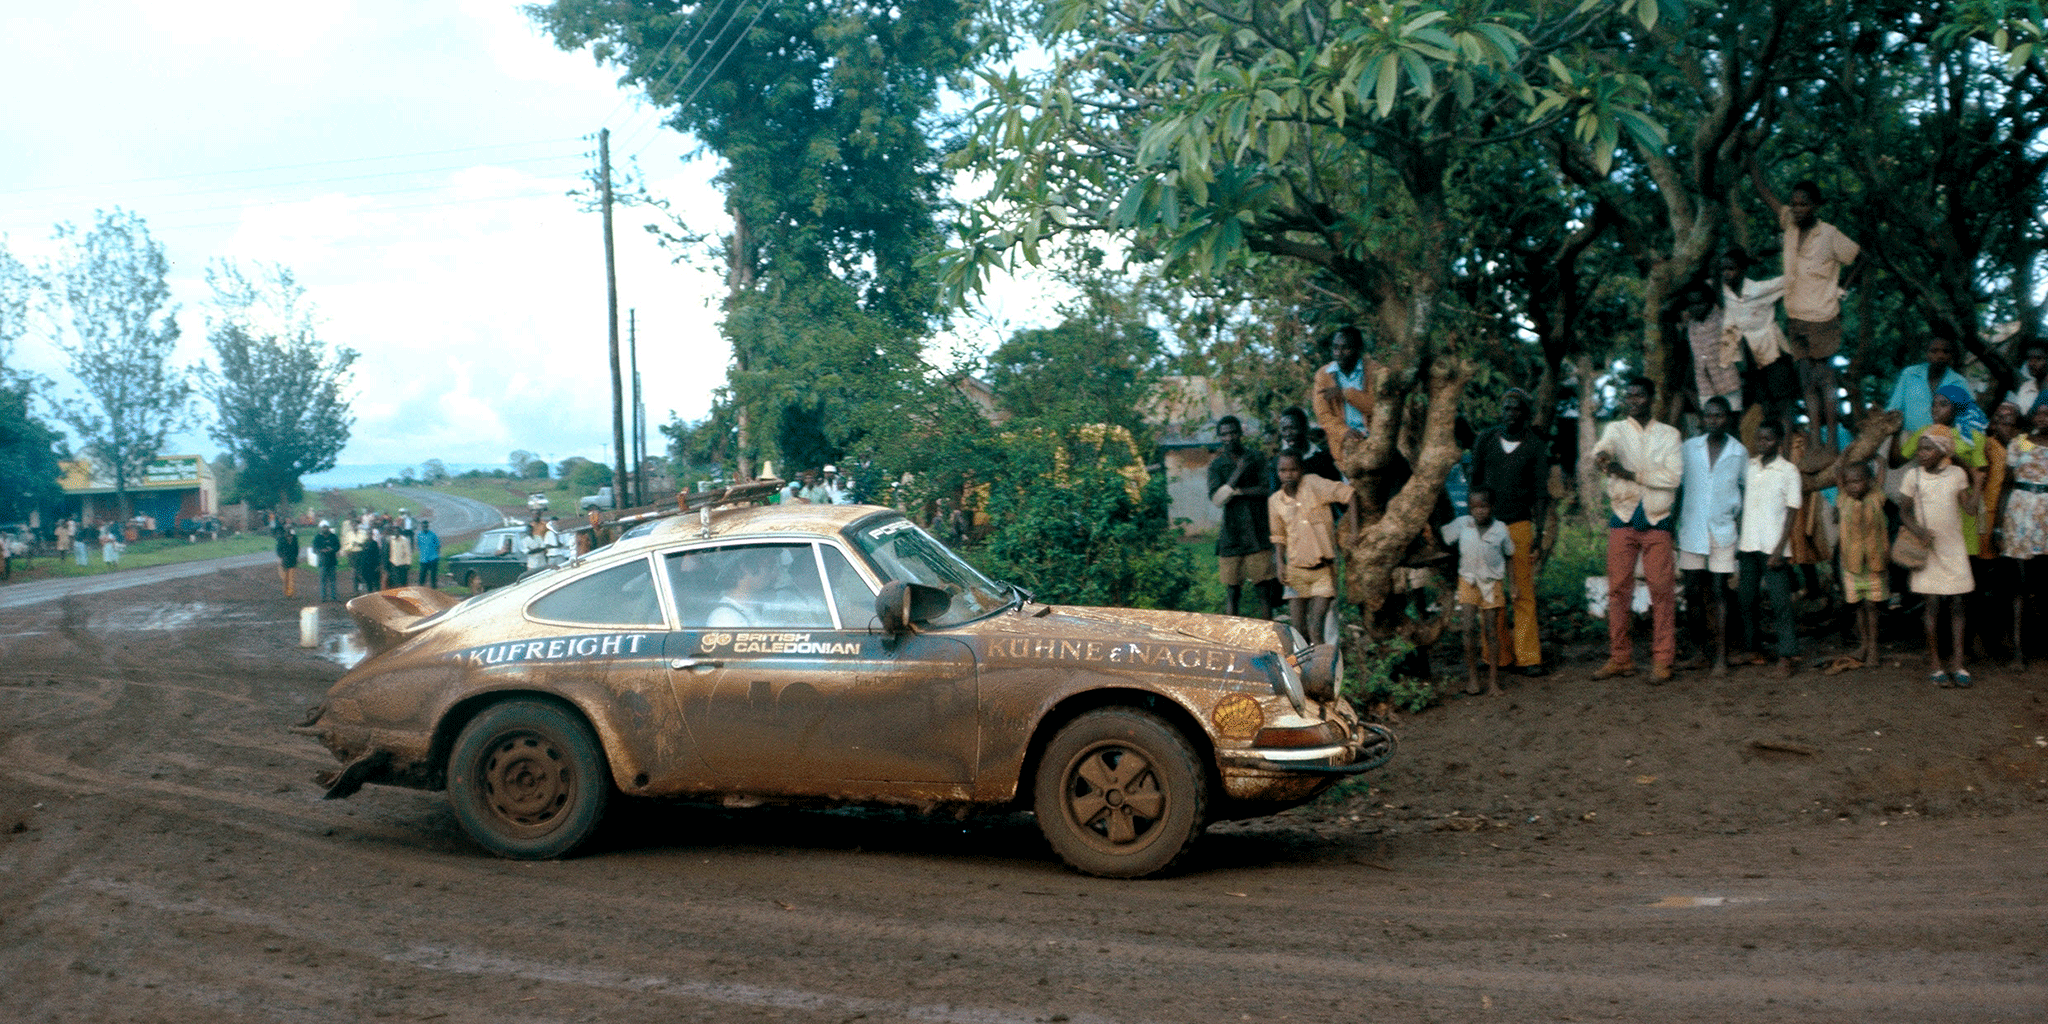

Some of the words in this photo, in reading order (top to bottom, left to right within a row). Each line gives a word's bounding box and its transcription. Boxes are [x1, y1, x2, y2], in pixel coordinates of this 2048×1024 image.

[735, 633, 811, 642] BRITISH
[733, 642, 860, 655] CALEDONIAN
[987, 638, 1104, 661] KÜHNE
[1129, 643, 1245, 674] NAGEL
